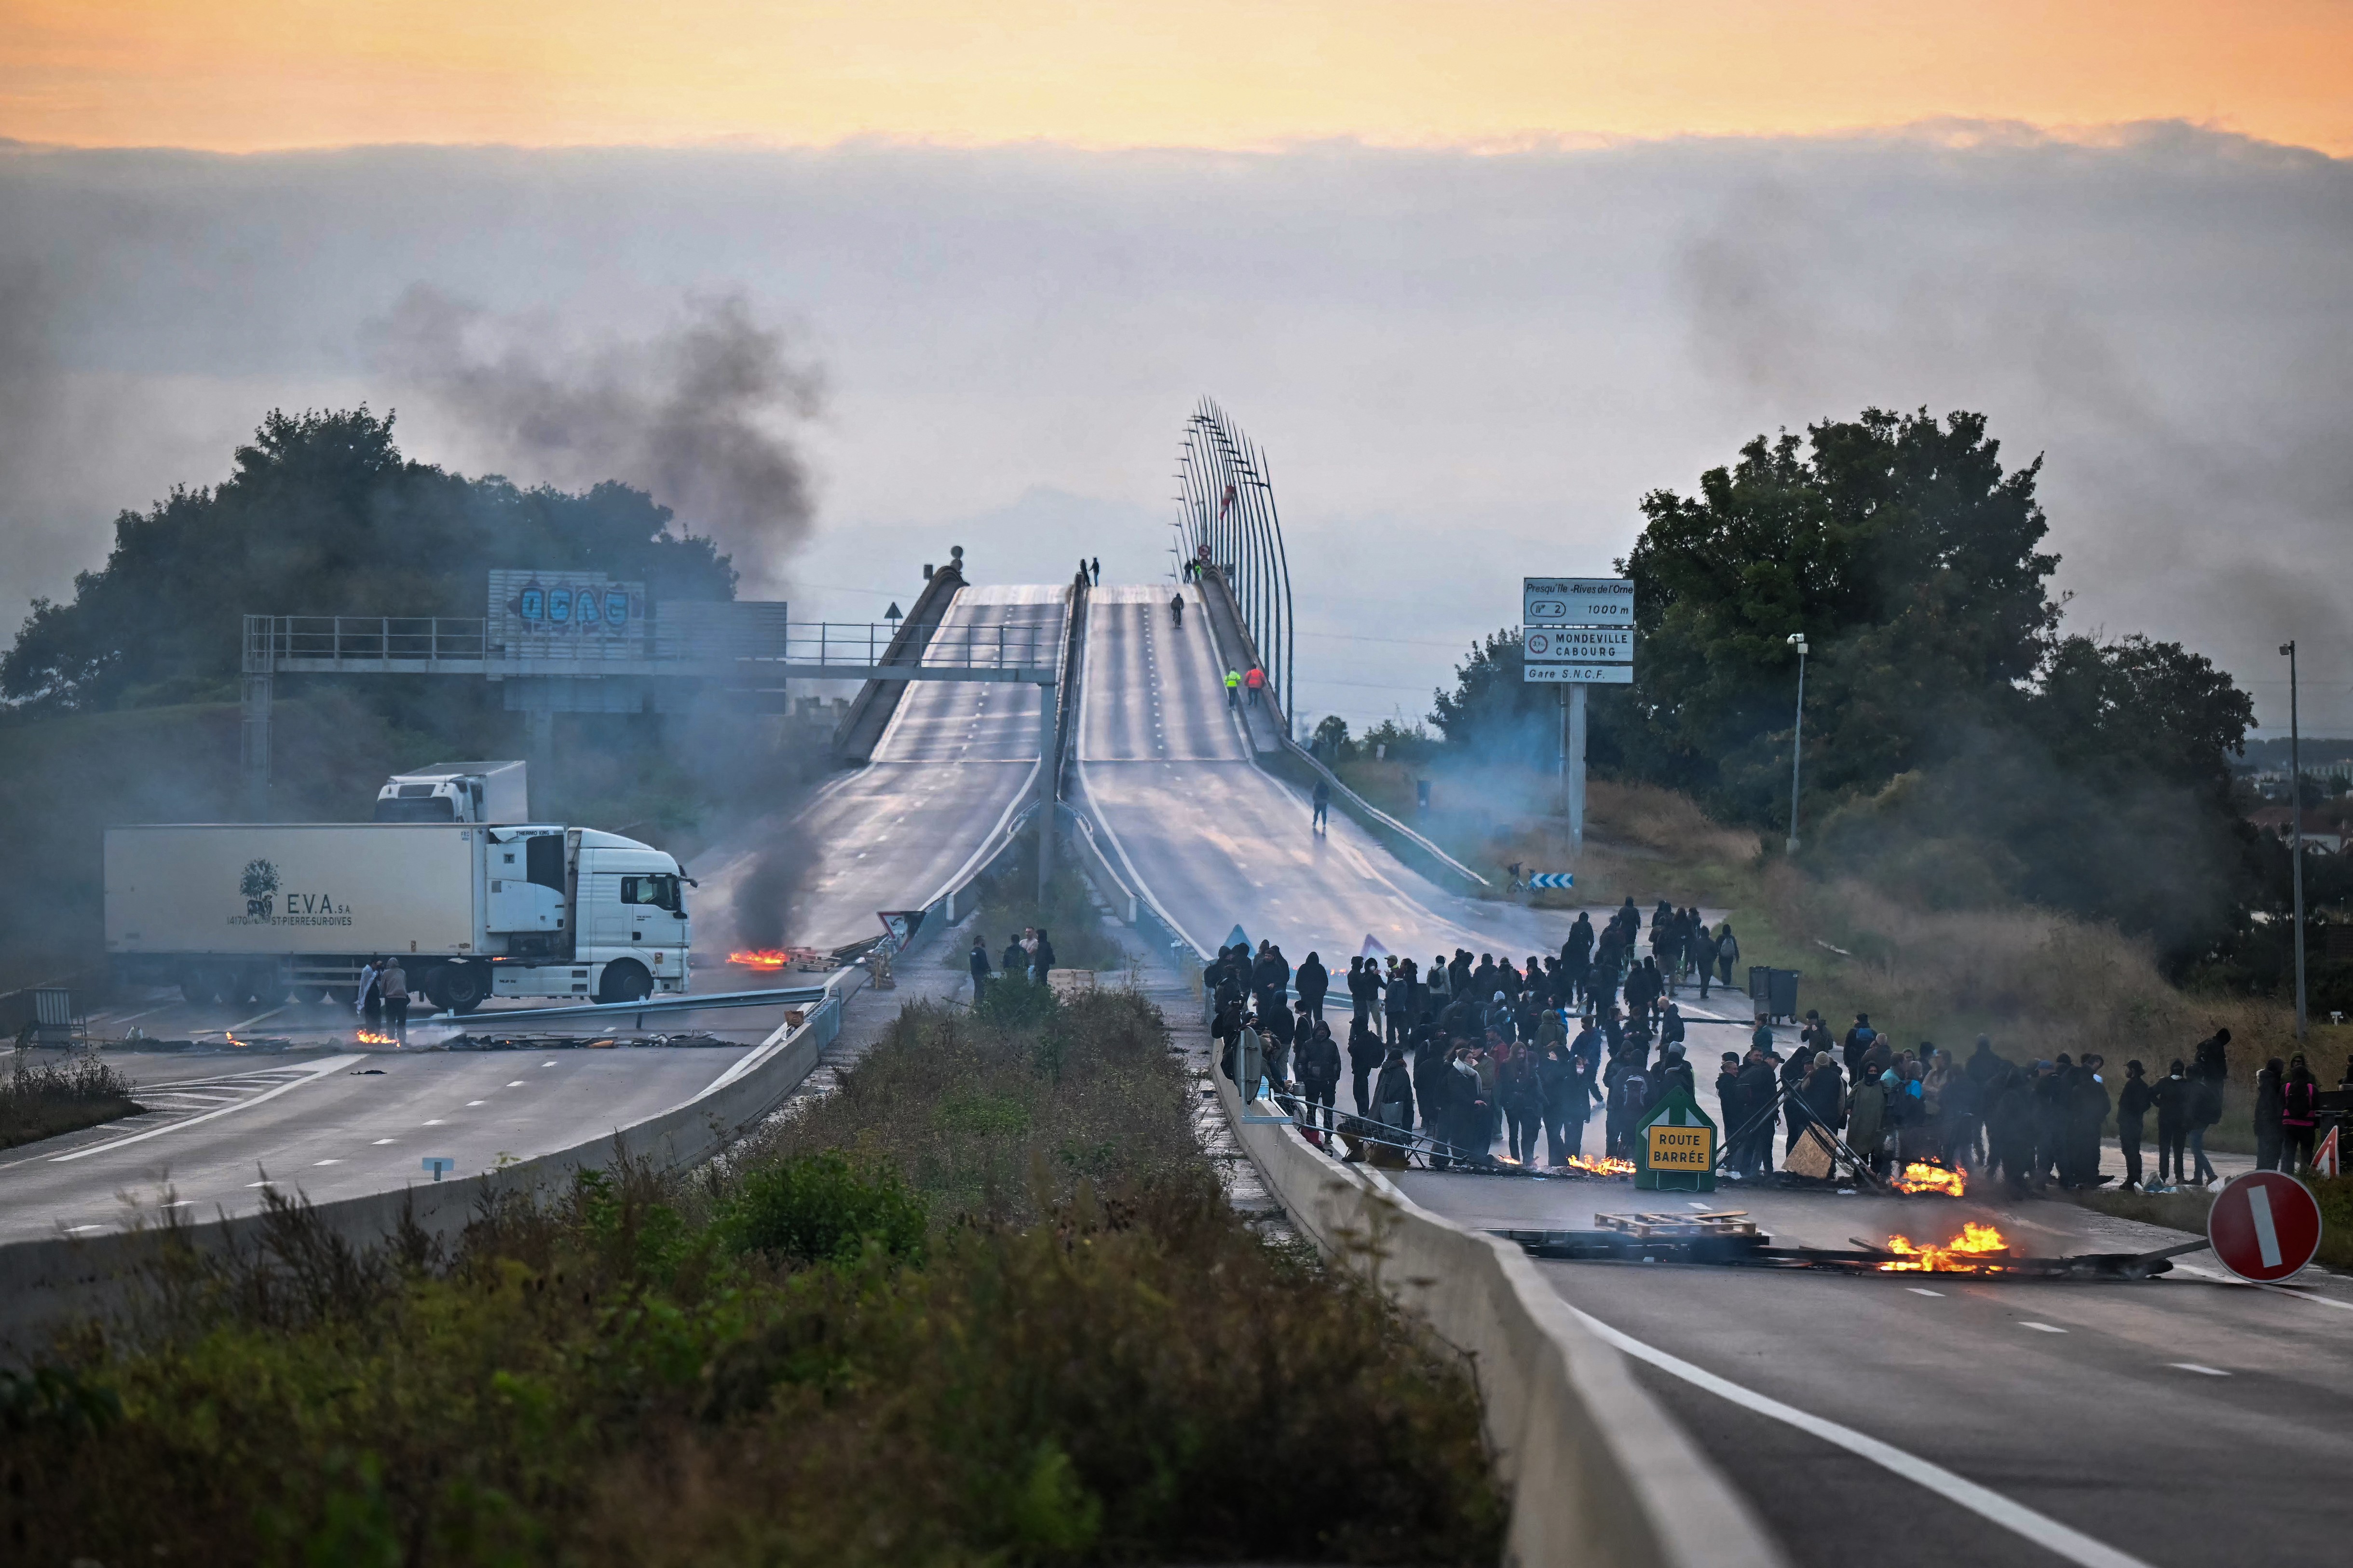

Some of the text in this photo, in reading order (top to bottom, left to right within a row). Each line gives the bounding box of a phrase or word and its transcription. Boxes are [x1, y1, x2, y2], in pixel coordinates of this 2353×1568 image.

[1526, 583, 1567, 595] Presqu'île
[1597, 585, 1609, 594] de
[1608, 584, 1633, 594] l'Orne
[1554, 605, 1561, 614] 2
[1588, 605, 1617, 614] 1000
[1556, 634, 1628, 644] MONDEVILLE
[1556, 648, 1616, 656] CABOURG
[1529, 669, 1605, 679] Gare S.N.C.F.
[227, 916, 352, 925] 14170 ST-PIERRE-SUR-DIVES
[1659, 1134, 1700, 1146] ROUTE
[1654, 1150, 1704, 1163] BARRÉE
